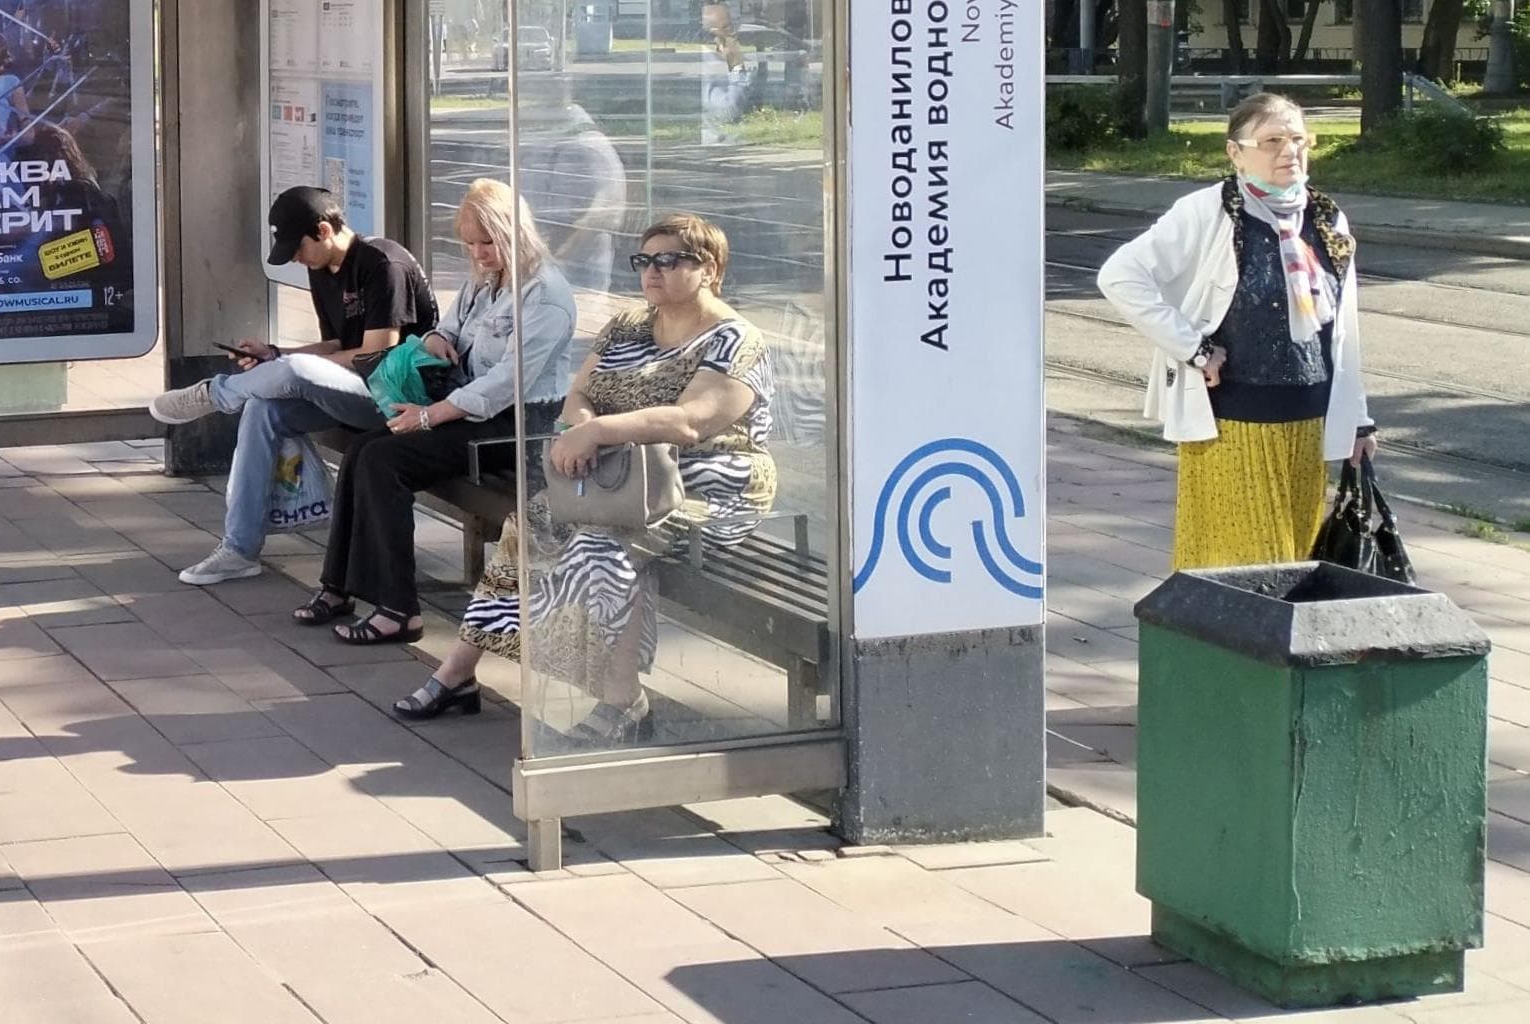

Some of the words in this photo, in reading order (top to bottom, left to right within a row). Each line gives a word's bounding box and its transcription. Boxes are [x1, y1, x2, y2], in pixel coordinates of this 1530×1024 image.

[920, 140, 953, 350] Академия
[103, 286, 124, 306] 12+
[270, 501, 328, 524] ента
